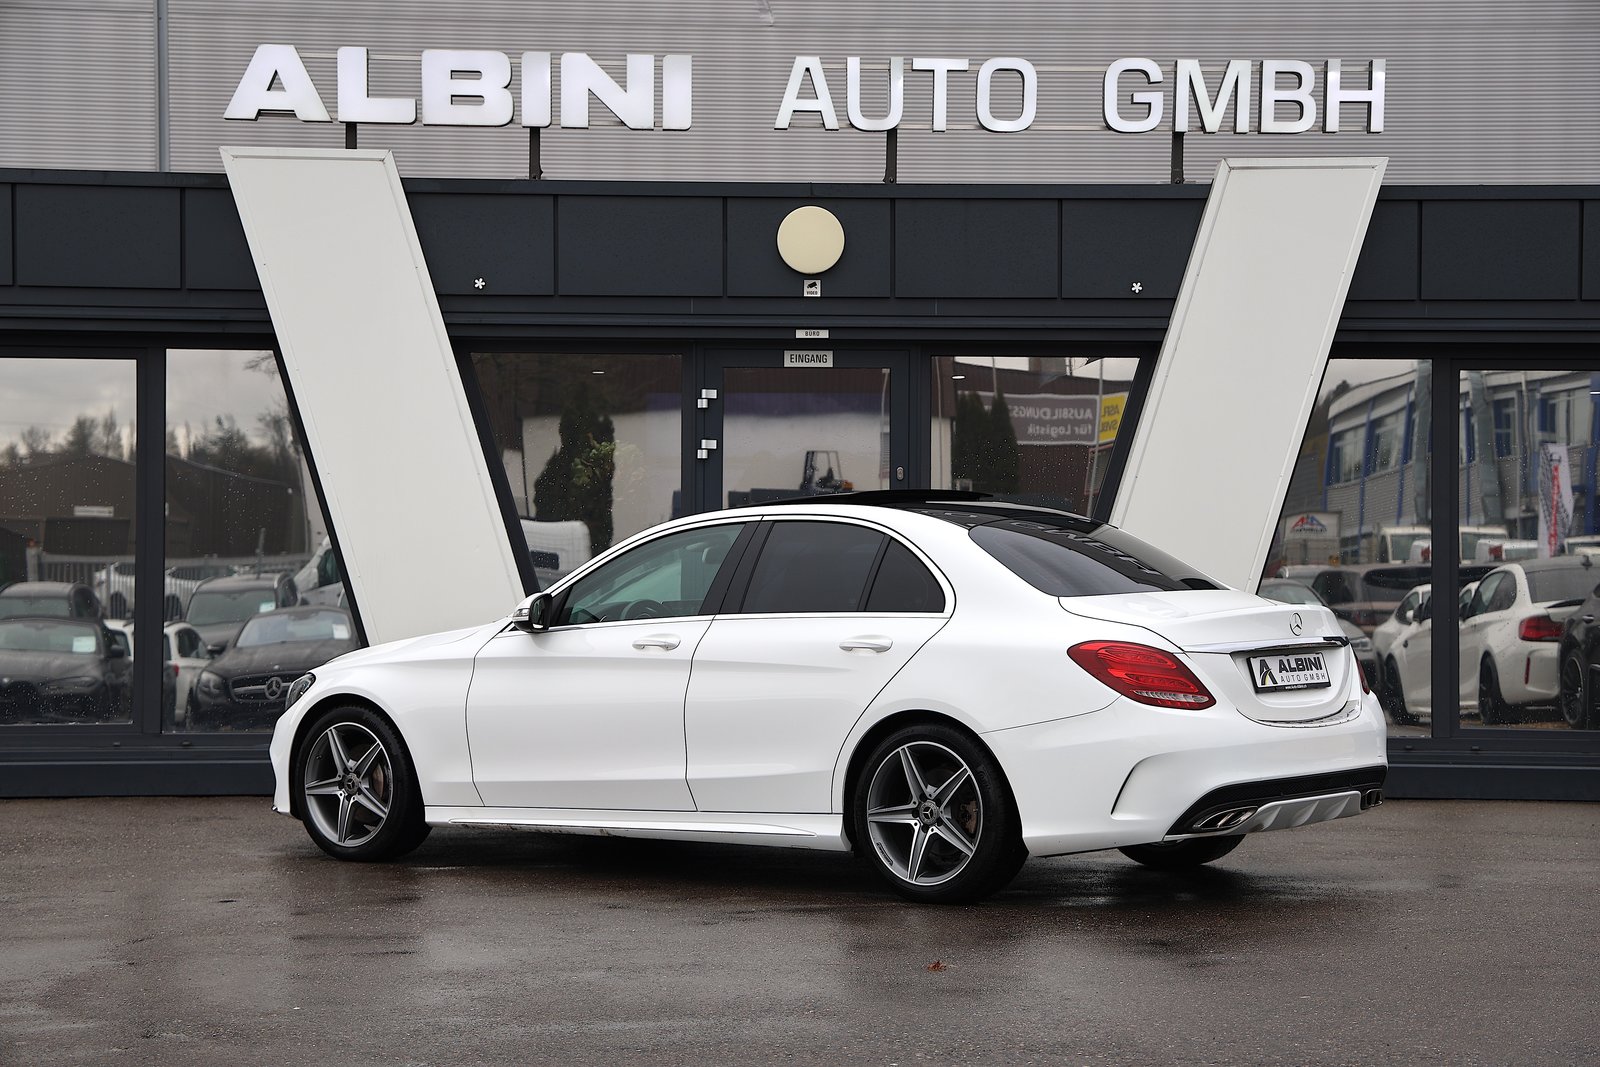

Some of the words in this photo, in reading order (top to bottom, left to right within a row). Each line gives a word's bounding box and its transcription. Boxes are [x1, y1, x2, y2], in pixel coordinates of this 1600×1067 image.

[223, 44, 692, 131] ALBINI
[774, 56, 1038, 134] AUTO
[1102, 57, 1386, 135] GMBH
[789, 354, 828, 363] EINGANG
[1279, 657, 1323, 673] ALBINI
[1280, 674, 1301, 683] AUTO
[1303, 673, 1326, 682] GMBH
